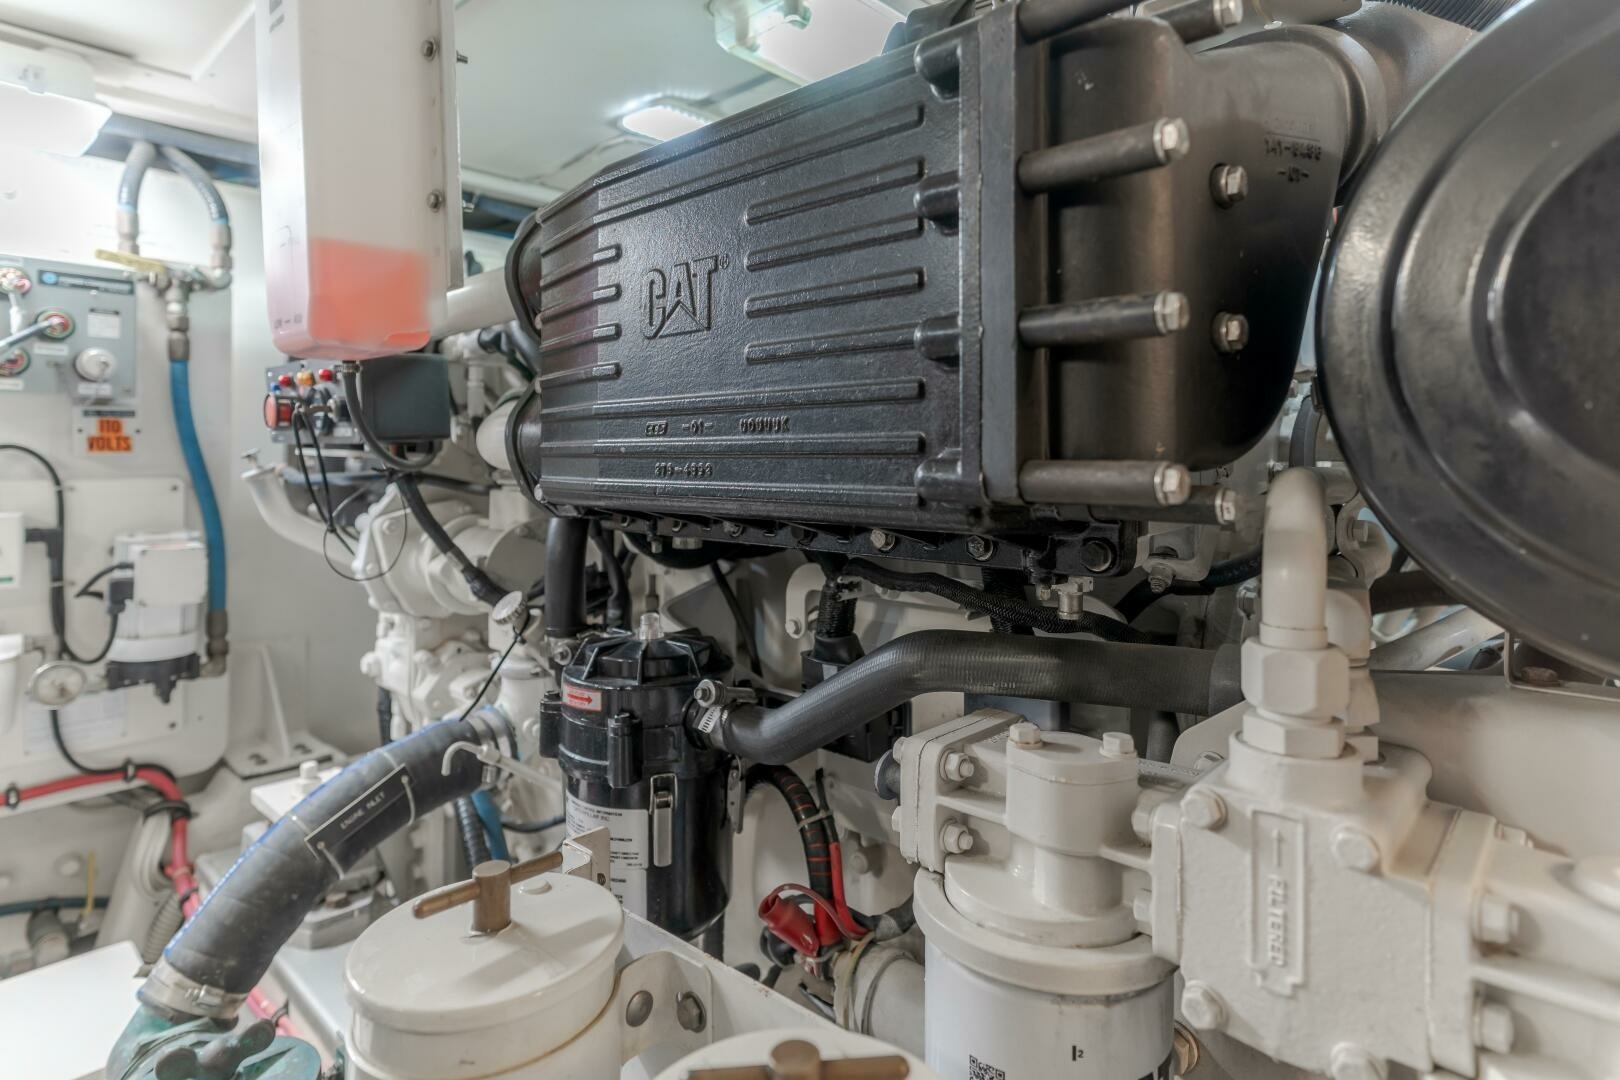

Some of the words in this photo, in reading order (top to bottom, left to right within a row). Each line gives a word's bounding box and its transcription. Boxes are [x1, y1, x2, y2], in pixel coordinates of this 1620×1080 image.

[642, 254, 718, 340] CAT
[99, 419, 122, 433] 110
[87, 436, 131, 451] VOLTS
